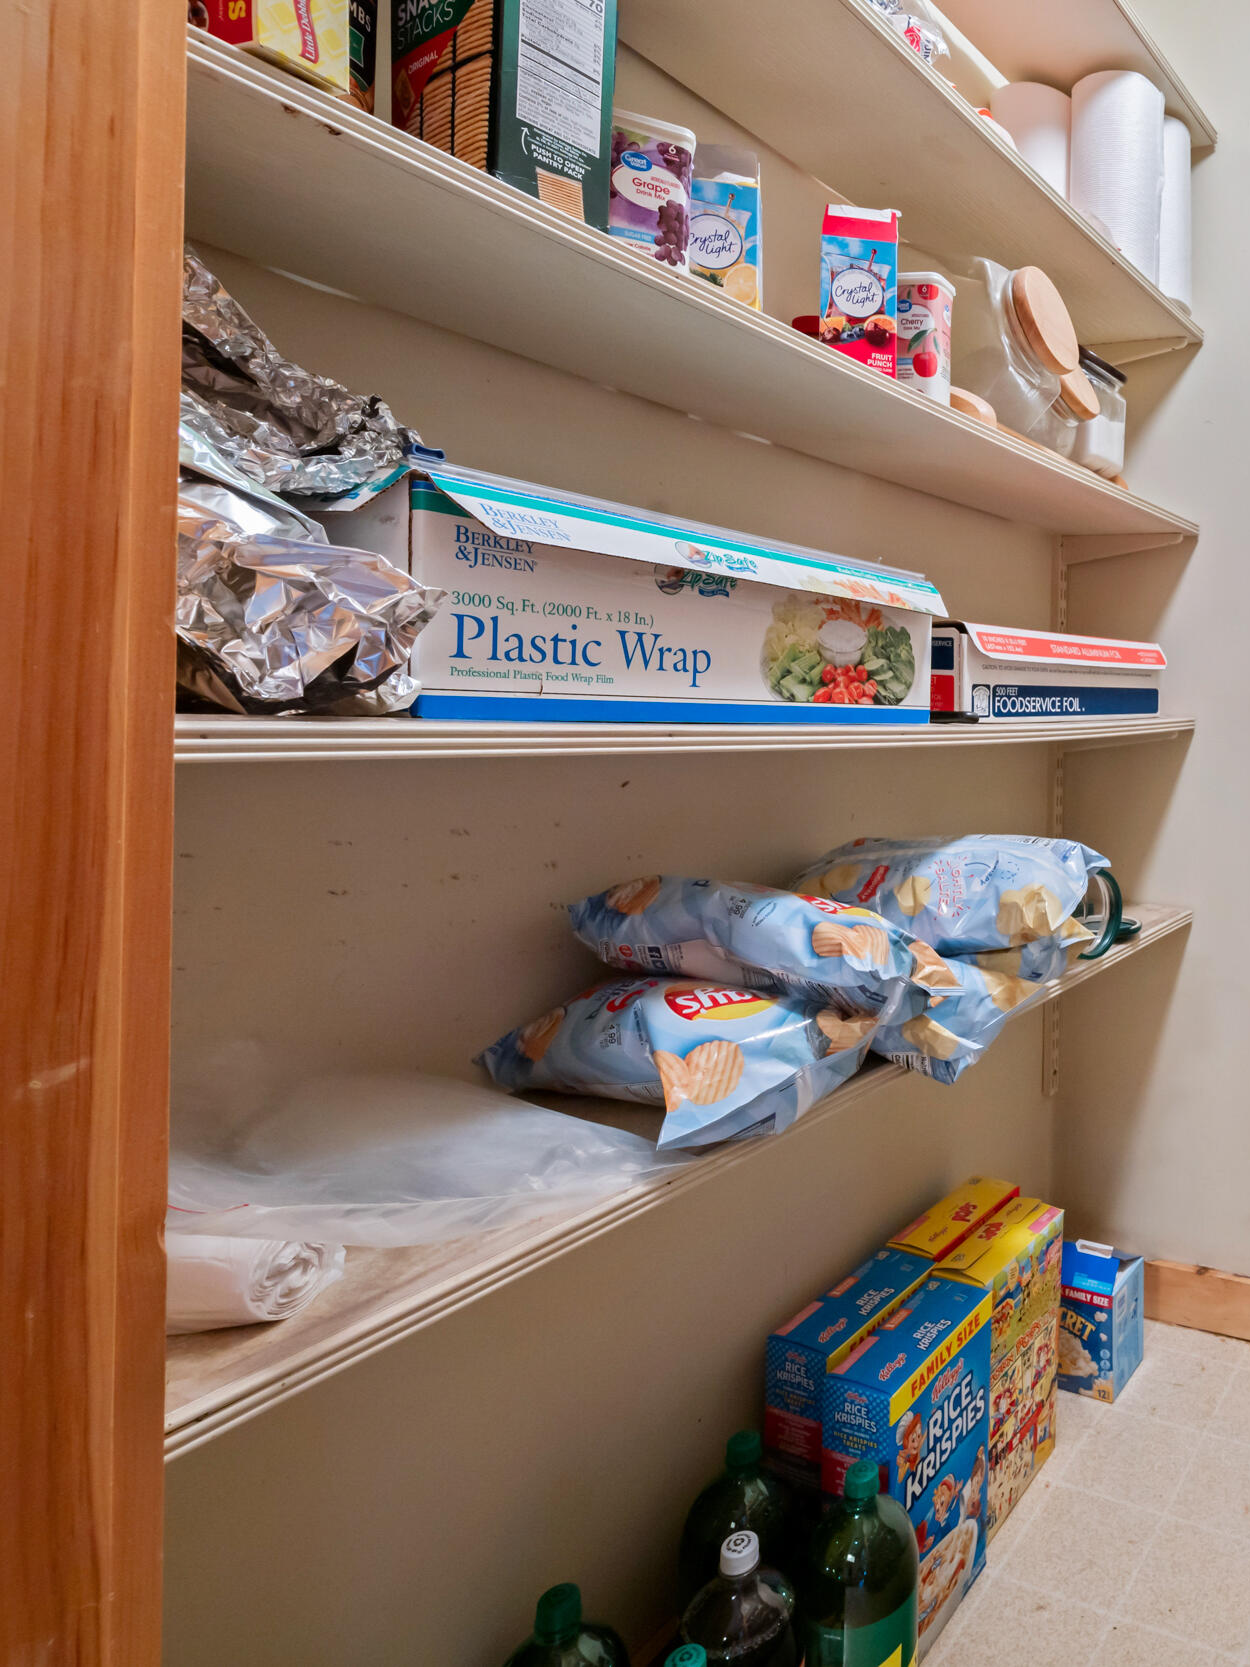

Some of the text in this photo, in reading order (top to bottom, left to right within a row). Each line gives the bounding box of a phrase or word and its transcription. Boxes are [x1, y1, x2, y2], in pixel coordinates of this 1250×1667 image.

[397, 0, 455, 50] STACKS
[408, 50, 439, 74] ORIGINAL
[531, 144, 585, 174] PUSH TO OPEN
[669, 145, 676, 154] 6
[533, 151, 583, 180] PANTRY PACK
[632, 177, 670, 196] Grape
[690, 230, 730, 252] Crystal
[835, 282, 873, 302] Crystal
[900, 318, 924, 328] Cherry
[867, 359, 893, 368] PUNCH
[871, 352, 893, 361] FRUIT
[479, 502, 560, 529] BERKLEY
[454, 524, 534, 554] BERKLEY
[451, 590, 654, 628] 3000 Sq. Ft. (2000 Ft. x 18 In.)
[449, 613, 711, 687] Plastic Wrap
[450, 667, 614, 685] Professional Plastic Food Wrap Film
[996, 687, 1018, 696] 500 FEET
[995, 697, 1061, 713] FOODSERVICE
[675, 987, 753, 1014] ay's
[952, 1202, 978, 1223] POPS
[856, 1288, 880, 1307] RICE
[858, 1287, 895, 1316] KRISPIES
[1065, 1288, 1109, 1307] FAMILY SIZE
[818, 1317, 848, 1343] Kellogg's
[913, 1321, 936, 1340] RICE
[917, 1319, 952, 1351] KRISPIES
[911, 1313, 980, 1398] FAMILY SIZE
[785, 1362, 806, 1377] RICE
[879, 1353, 907, 1381] Kellogg's
[776, 1370, 815, 1391] KRISPIES
[932, 1357, 964, 1403] Kellogg's
[844, 1402, 868, 1418] RICE
[929, 1372, 972, 1449] RICE
[834, 1411, 877, 1433] KRISPIES
[905, 1388, 985, 1511] KRISPIES
